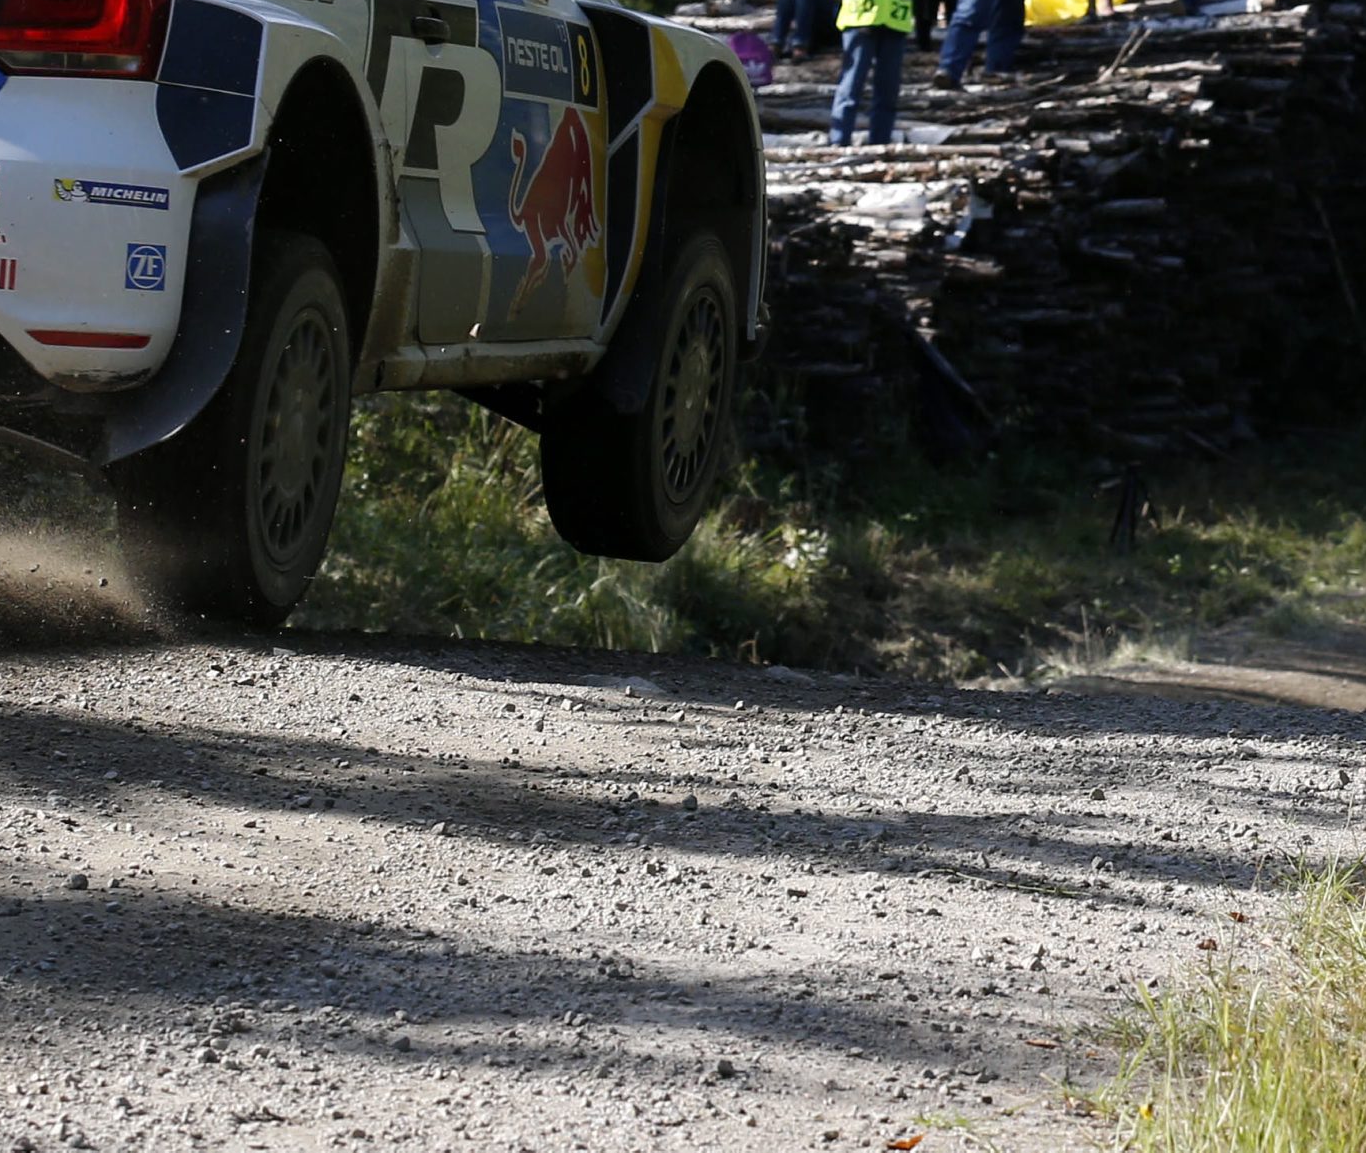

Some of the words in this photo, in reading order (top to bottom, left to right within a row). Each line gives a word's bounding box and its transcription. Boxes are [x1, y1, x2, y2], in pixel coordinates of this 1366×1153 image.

[577, 34, 590, 96] 8
[91, 185, 167, 204] MICHELIN
[131, 254, 162, 280] ZF
